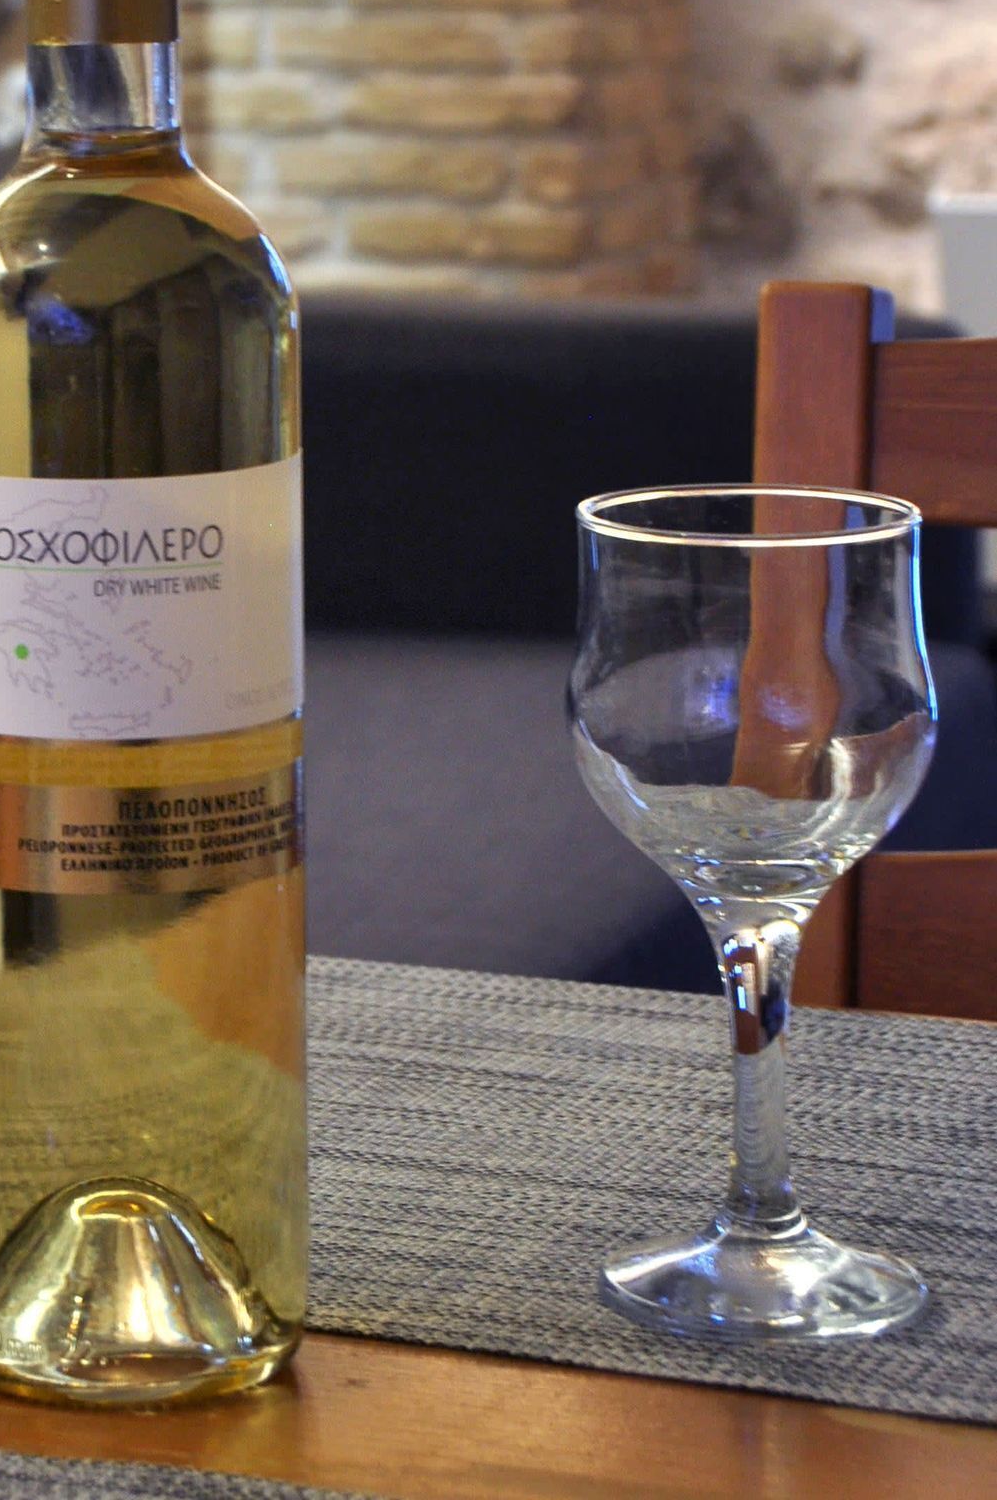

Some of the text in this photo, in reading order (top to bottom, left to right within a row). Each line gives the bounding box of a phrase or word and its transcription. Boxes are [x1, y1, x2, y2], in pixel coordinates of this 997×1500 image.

[93, 573, 222, 598] DRY WHITE WINE
[119, 786, 266, 820] ΠΕΛΟΠΟΝΝΗΣΟΣ
